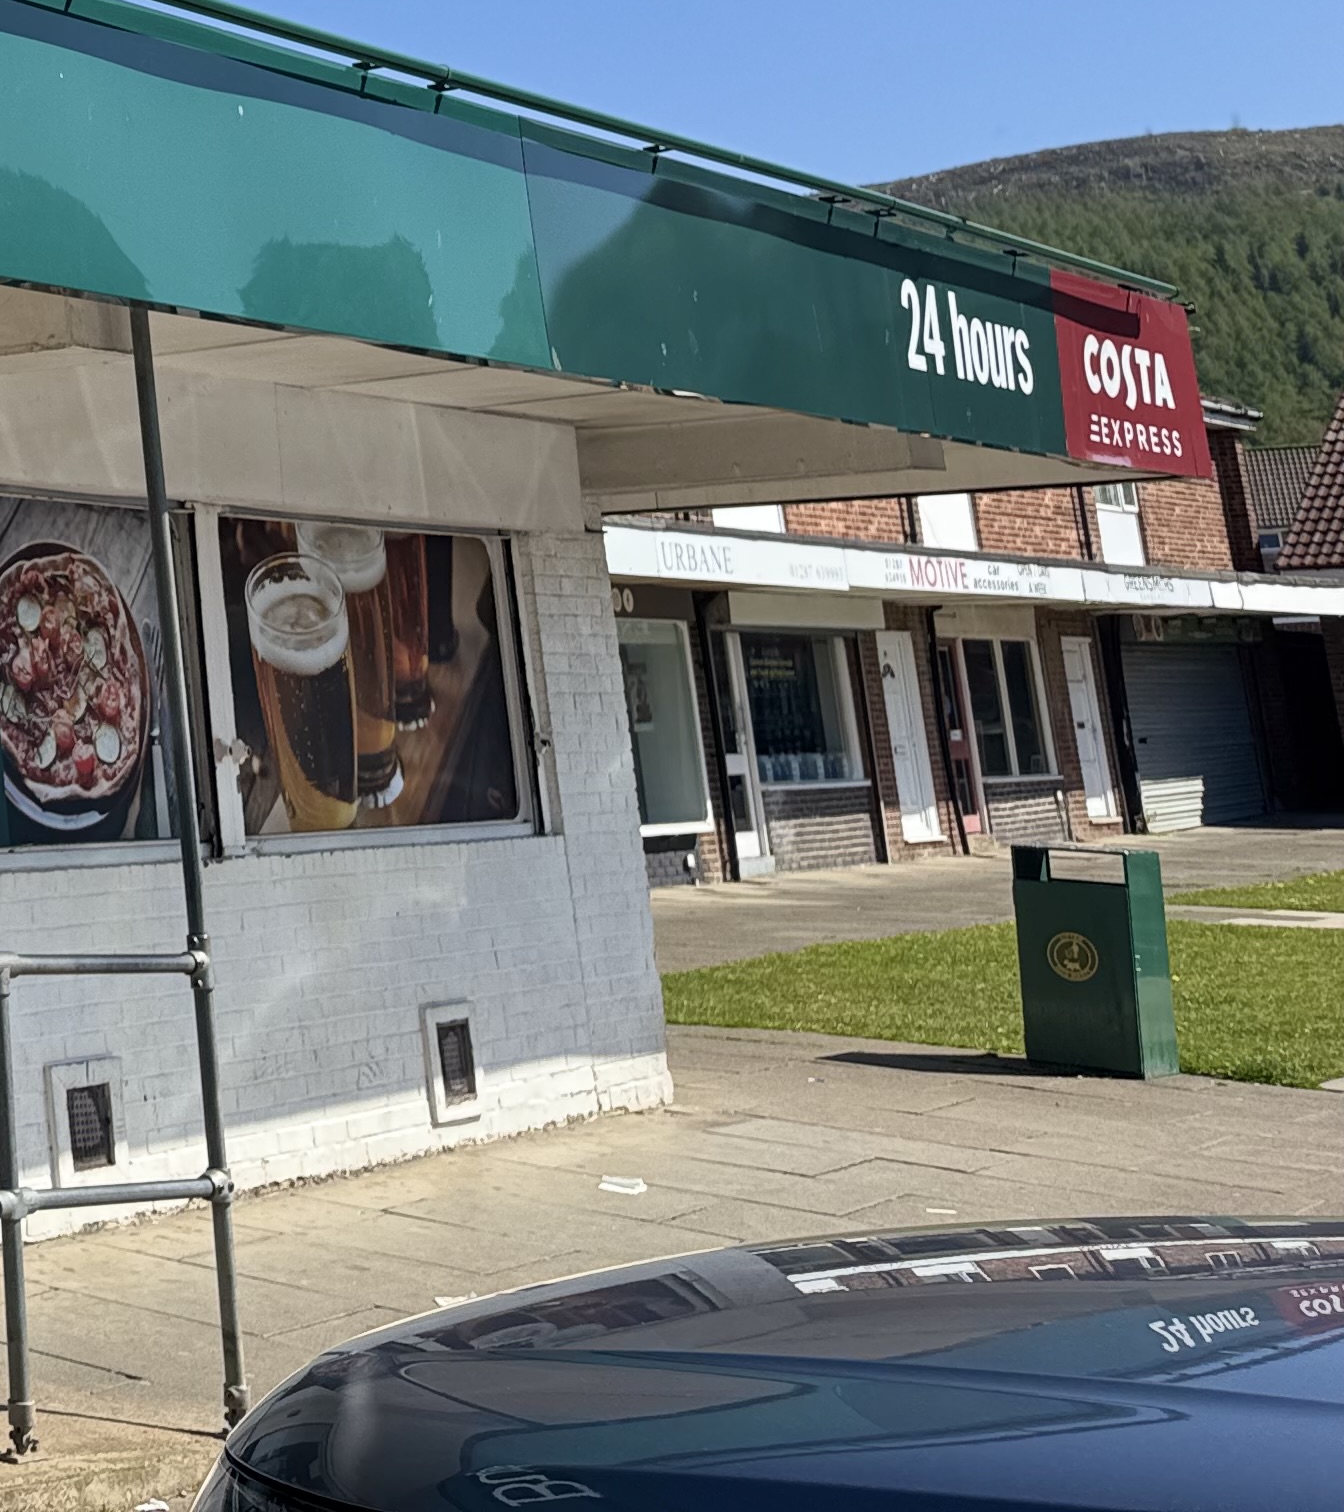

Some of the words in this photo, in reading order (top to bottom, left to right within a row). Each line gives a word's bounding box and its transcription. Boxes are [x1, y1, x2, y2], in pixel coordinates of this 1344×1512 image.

[900, 278, 946, 376] 24
[947, 290, 1034, 396] hours
[1083, 334, 1176, 411] COSTA
[1099, 417, 1183, 458] EXPRESS
[660, 541, 734, 575] URBANE
[909, 556, 969, 590] MOTIVE
[987, 564, 1000, 577] car
[973, 574, 1019, 591] accessories
